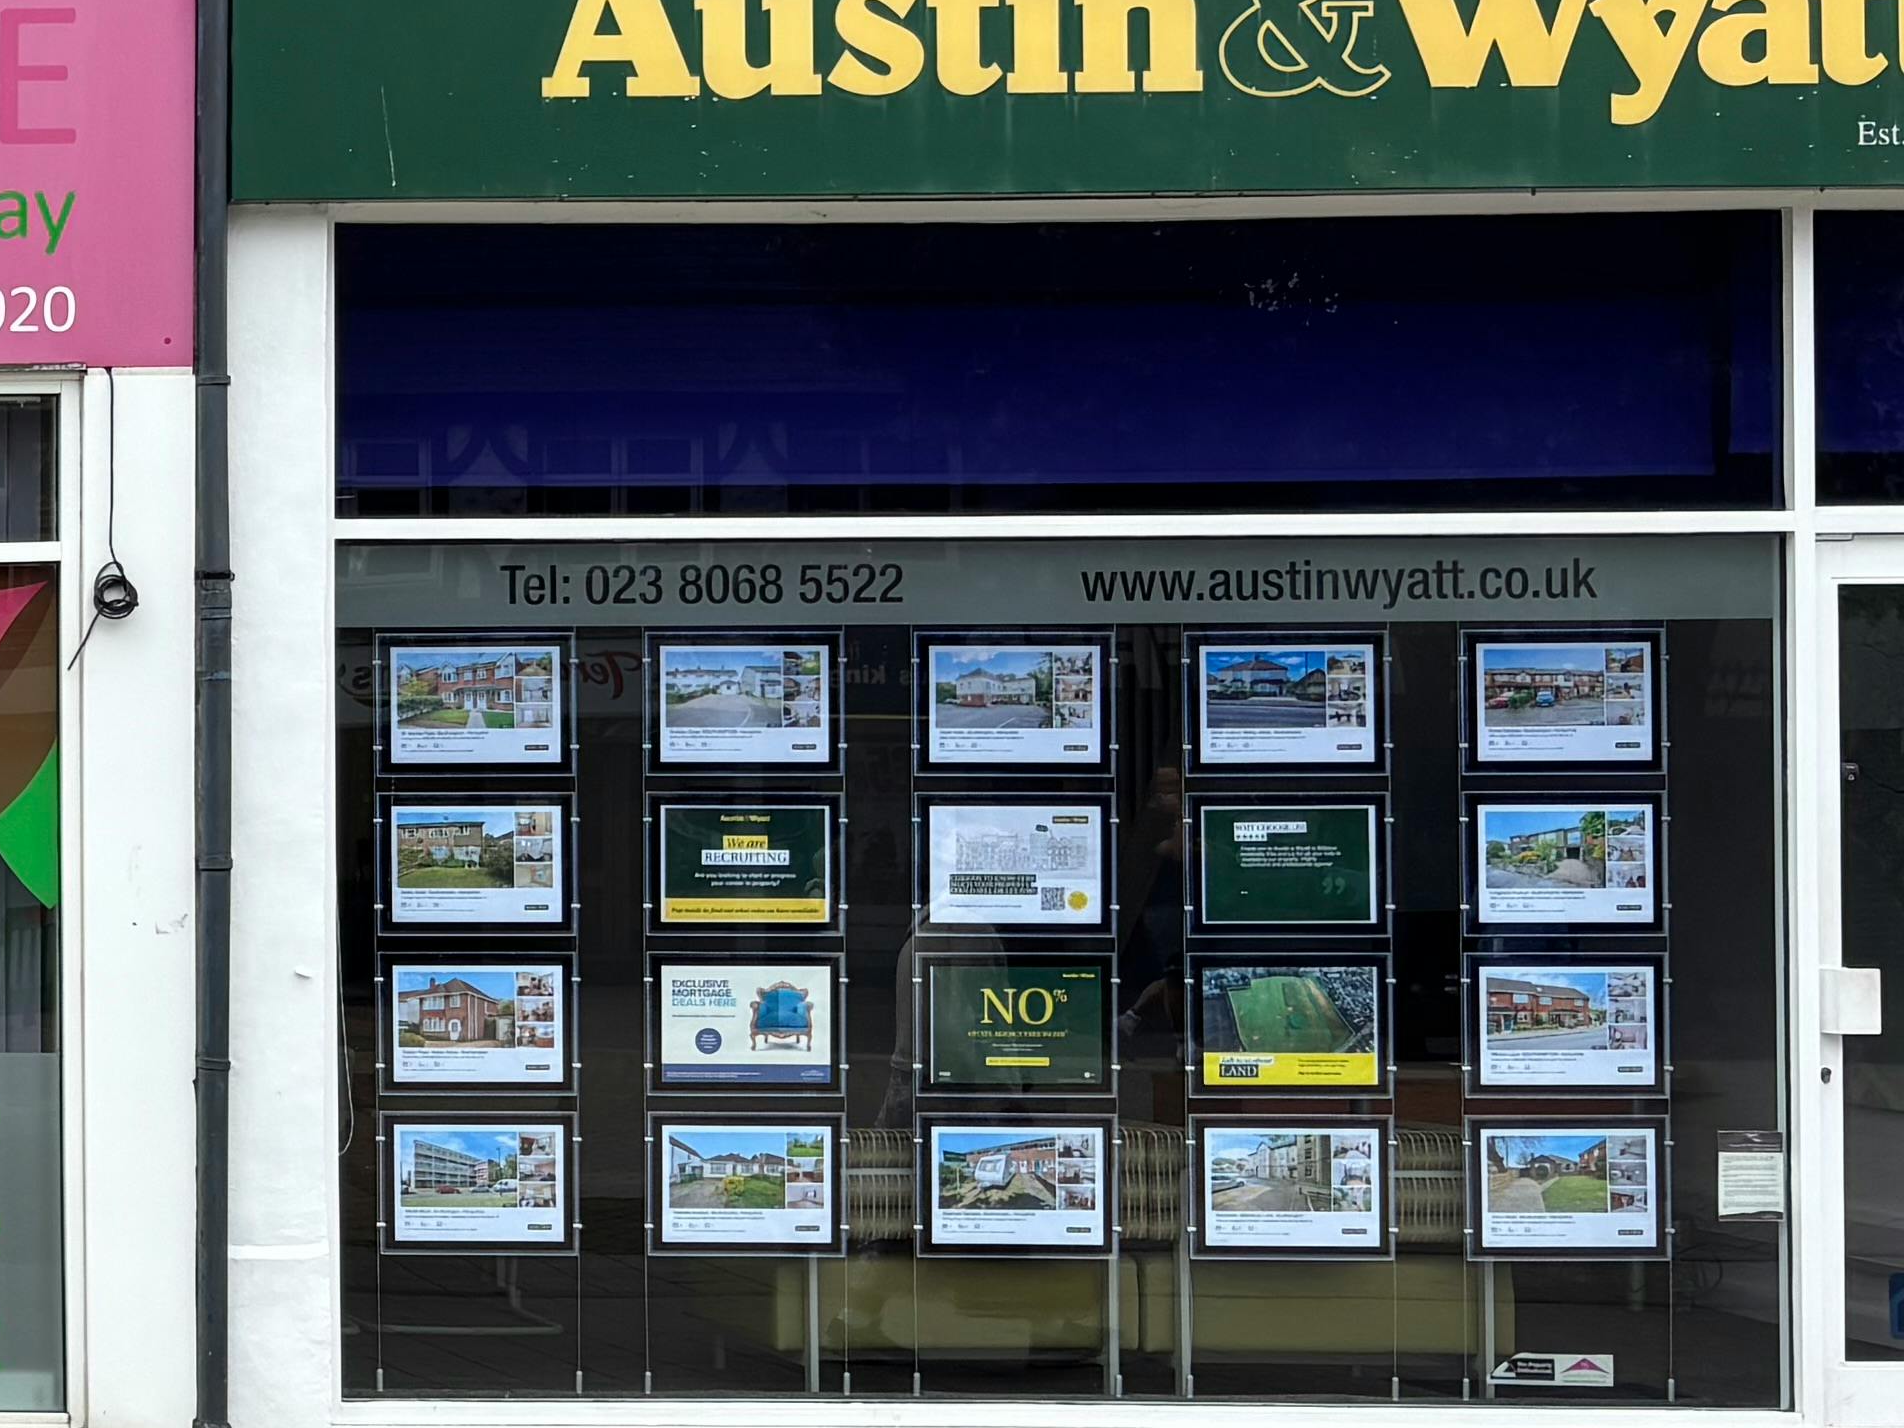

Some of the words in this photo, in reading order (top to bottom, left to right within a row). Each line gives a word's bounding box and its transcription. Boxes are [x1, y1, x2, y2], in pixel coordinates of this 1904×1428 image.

[500, 564, 572, 606] Tel:
[585, 565, 664, 606] 023
[678, 564, 785, 606] 8068
[798, 563, 905, 605] 5522
[1081, 558, 1599, 610] www.austinwyatt.co.uk
[720, 814, 744, 823] Austin
[750, 814, 771, 824] Wyatt
[726, 837, 745, 849] We
[746, 839, 767, 849] are
[704, 852, 787, 864] RECRUITING
[671, 979, 729, 988] EXCLUSIVE
[671, 989, 732, 998] MORTGAGE
[671, 997, 706, 1007] DEALS
[708, 998, 737, 1008] HERE
[1220, 1064, 1257, 1077] LAND
